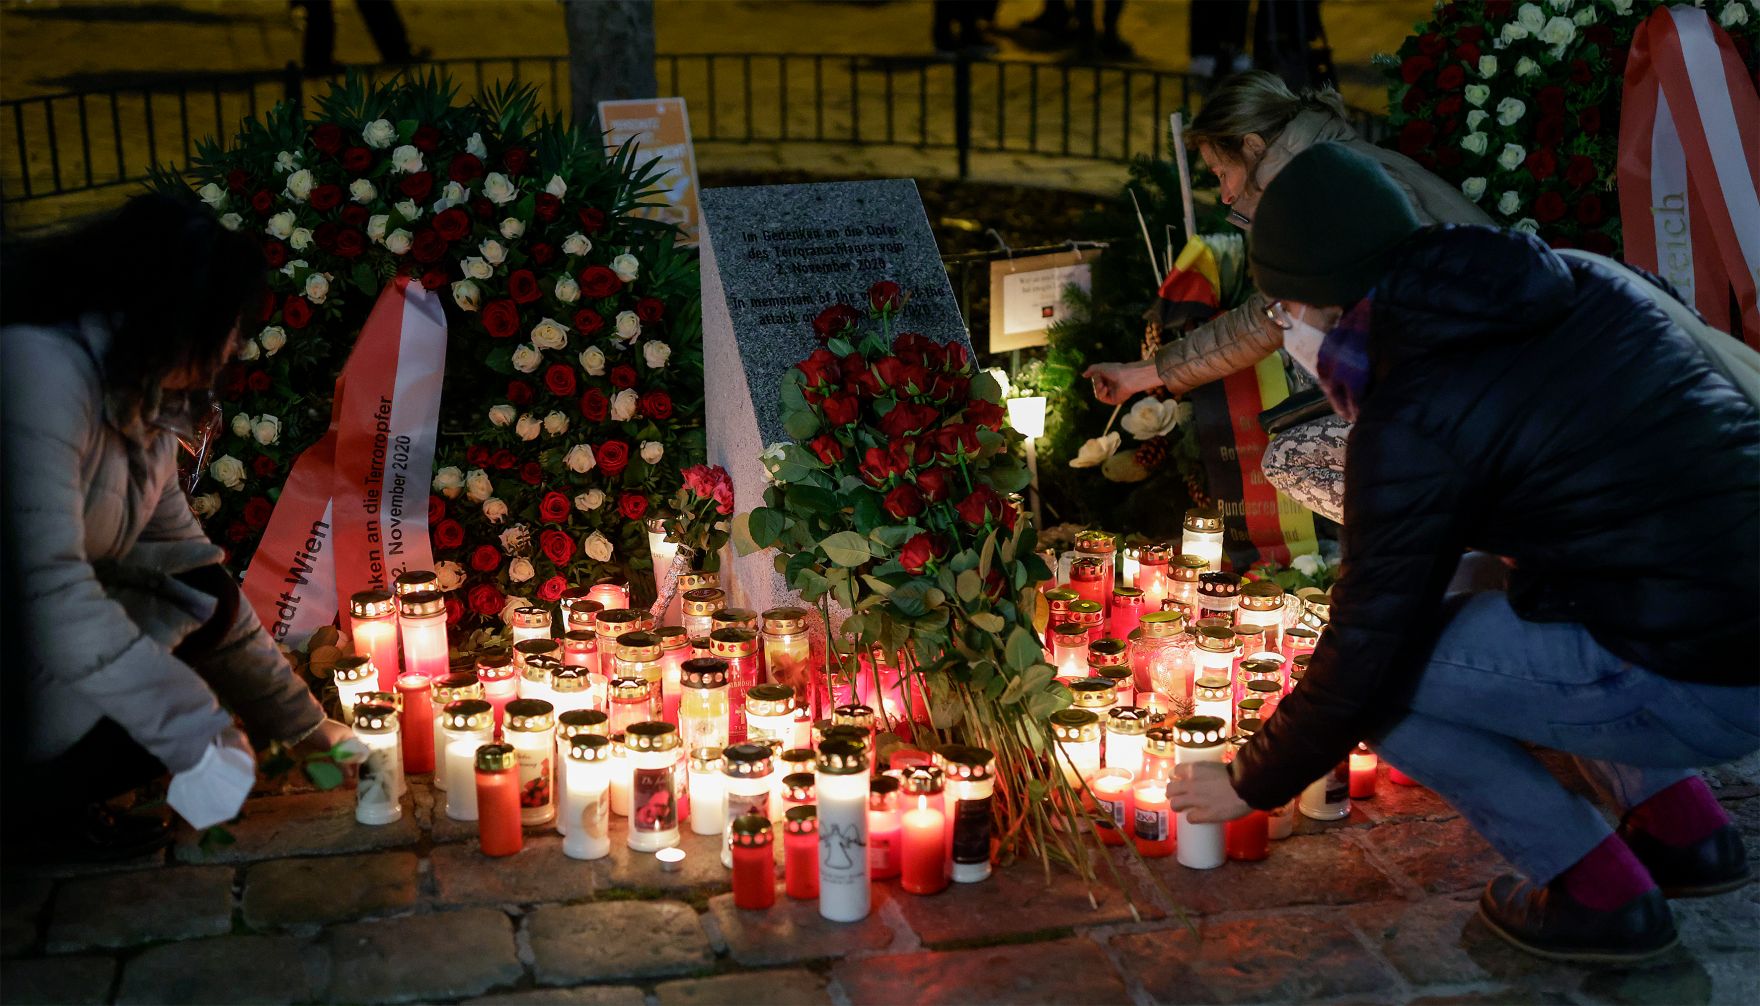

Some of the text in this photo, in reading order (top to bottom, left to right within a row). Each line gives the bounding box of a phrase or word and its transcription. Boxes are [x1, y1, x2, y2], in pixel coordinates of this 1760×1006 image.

[742, 223, 898, 242] Im Gedenken an die Opfer
[748, 247, 769, 259] des
[879, 242, 904, 254] vom
[791, 258, 852, 274] November
[856, 258, 886, 271] 2020
[819, 291, 831, 304] of
[835, 290, 855, 302] the
[759, 310, 798, 325] attack
[364, 395, 393, 487] Terroropfer
[392, 435, 411, 470] 2020
[363, 489, 379, 514] die
[388, 474, 406, 555] November
[366, 520, 380, 543] an
[284, 520, 330, 585] Wien
